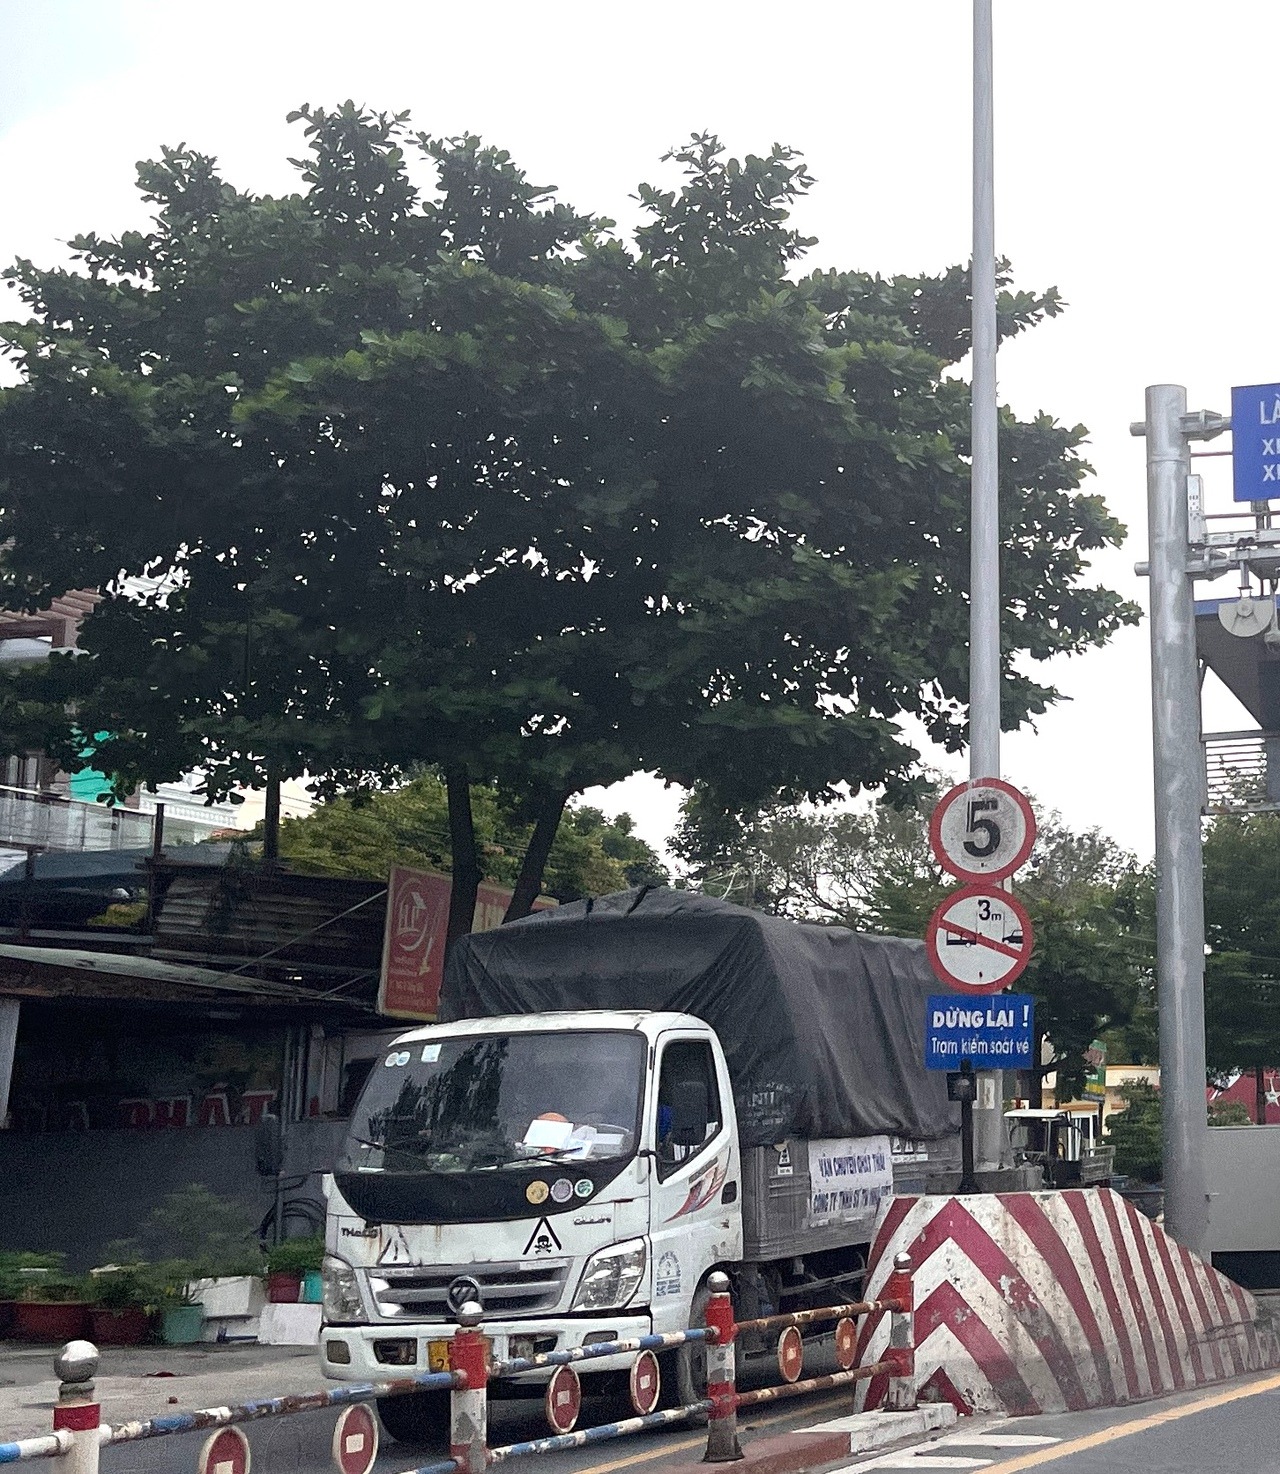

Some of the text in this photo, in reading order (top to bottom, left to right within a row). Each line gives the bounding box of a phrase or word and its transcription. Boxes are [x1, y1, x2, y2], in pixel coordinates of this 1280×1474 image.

[963, 800, 1000, 857] 5
[932, 1006, 984, 1028] DỪNG
[986, 1010, 1014, 1031] LẠI
[931, 1033, 1029, 1056] Trạm kiểm soát vé
